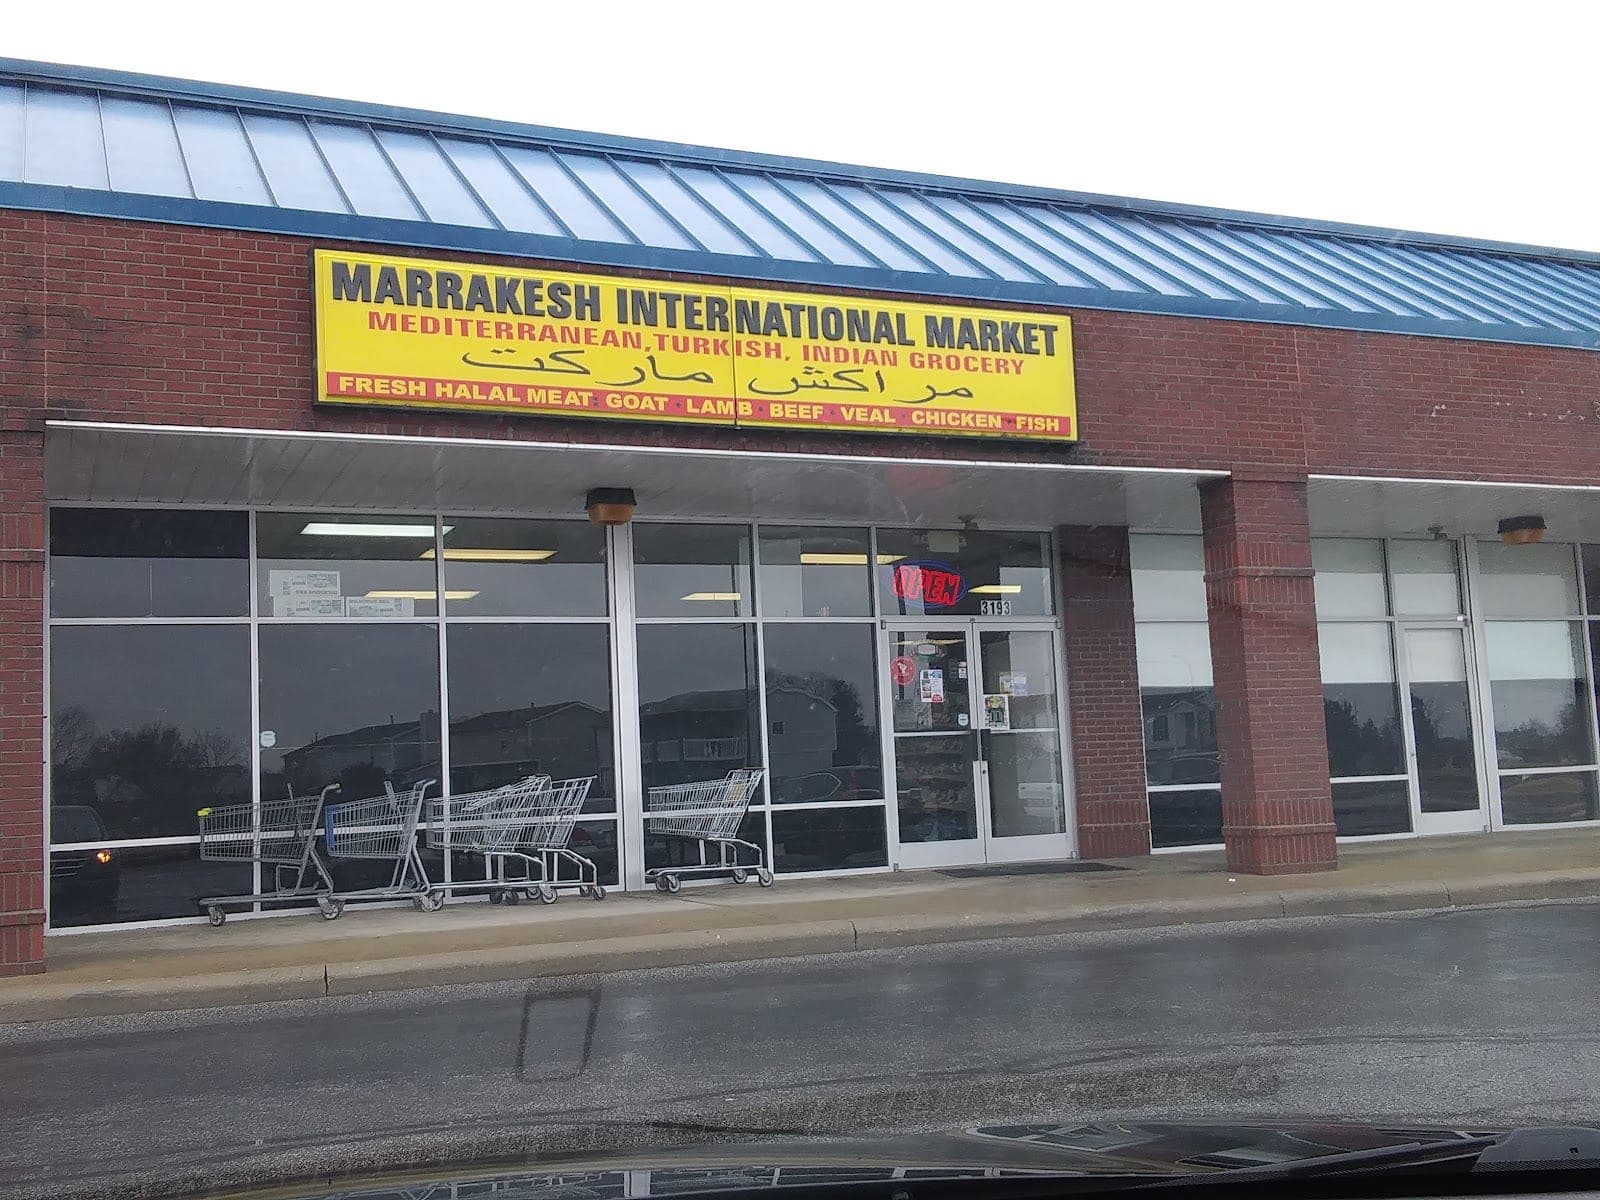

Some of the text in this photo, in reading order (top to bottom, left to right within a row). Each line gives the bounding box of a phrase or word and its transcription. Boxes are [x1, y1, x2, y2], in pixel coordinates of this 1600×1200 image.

[331, 261, 1058, 356] MARRAKESH INTERNATIONAL MARKET
[803, 344, 897, 367] INDIAN
[910, 355, 1025, 375] GROCERY
[339, 376, 1060, 432] FRESH HALAL MEAT GOAT LAMB BEEF VEAL CHICKEN FISH
[893, 565, 960, 605] OPEN
[981, 601, 1011, 615] 3193
